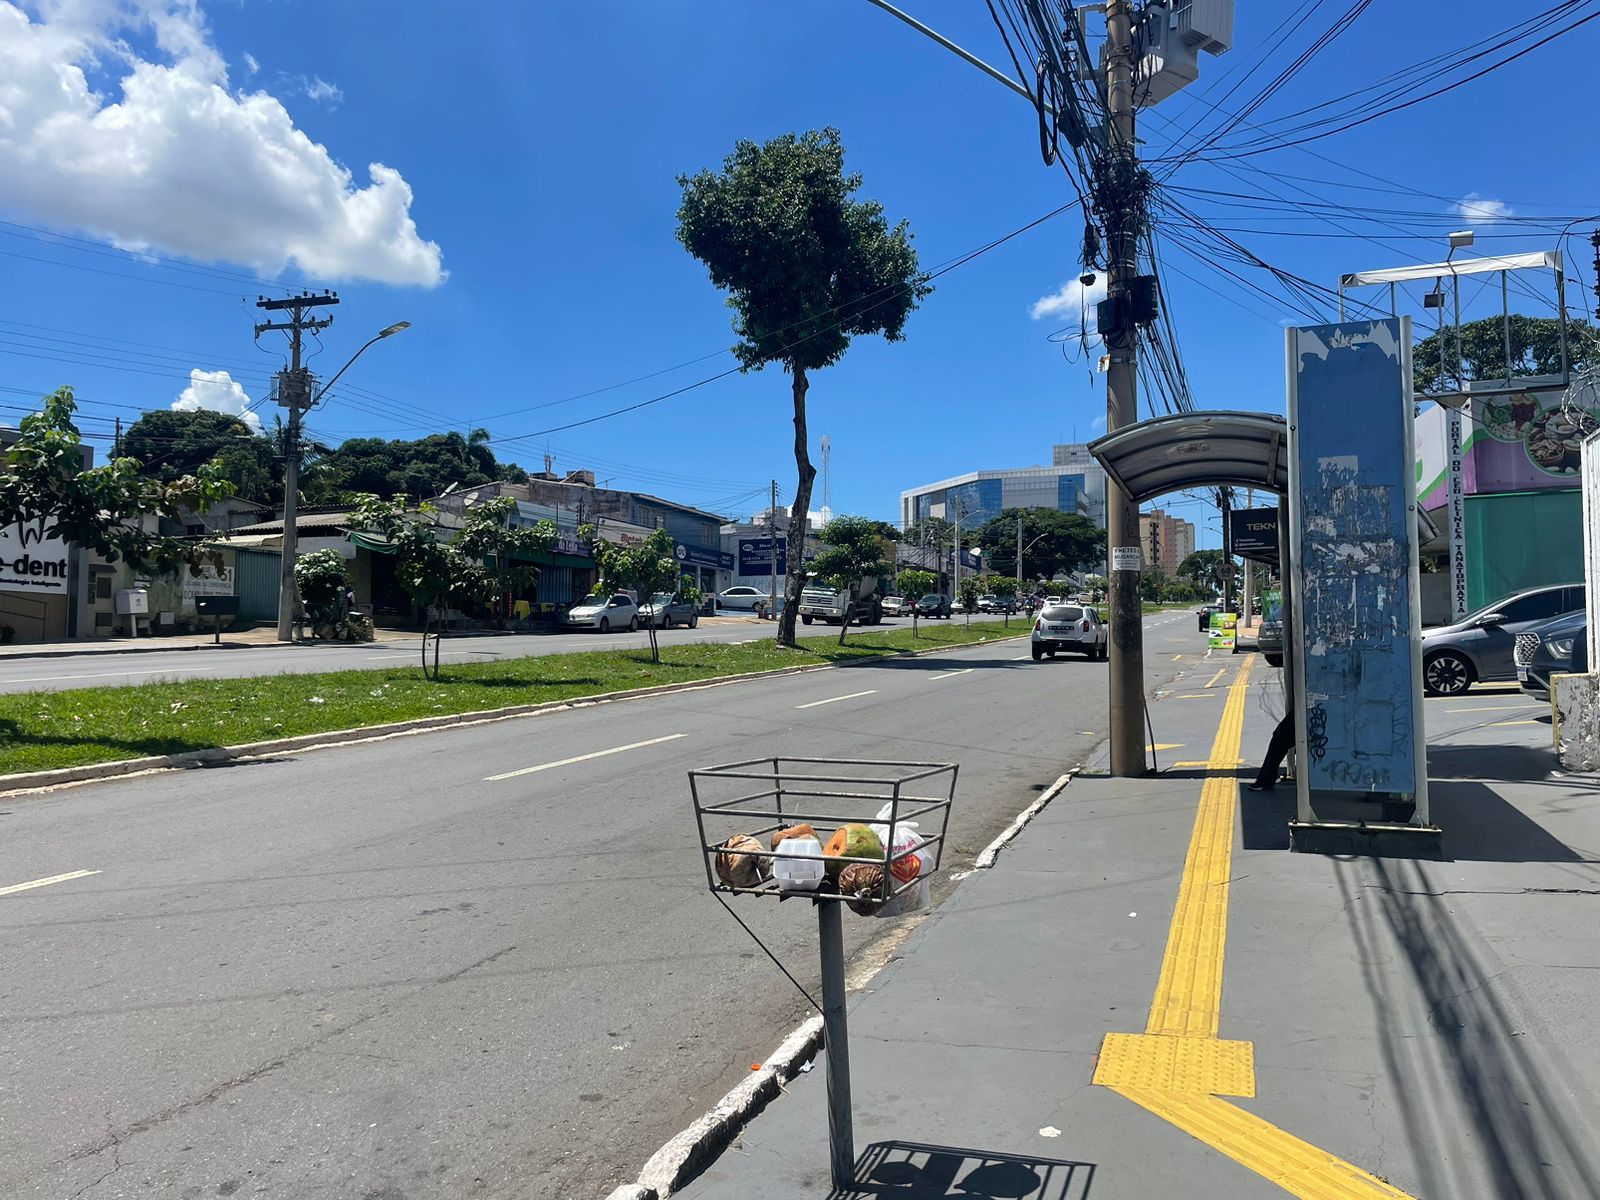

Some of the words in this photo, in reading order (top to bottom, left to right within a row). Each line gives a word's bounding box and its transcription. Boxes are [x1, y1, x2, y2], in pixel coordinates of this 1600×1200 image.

[1451, 421, 1460, 456] PORTAL
[1452, 460, 1461, 471] DO
[1455, 544, 1466, 613] TANATOPRAXIA
